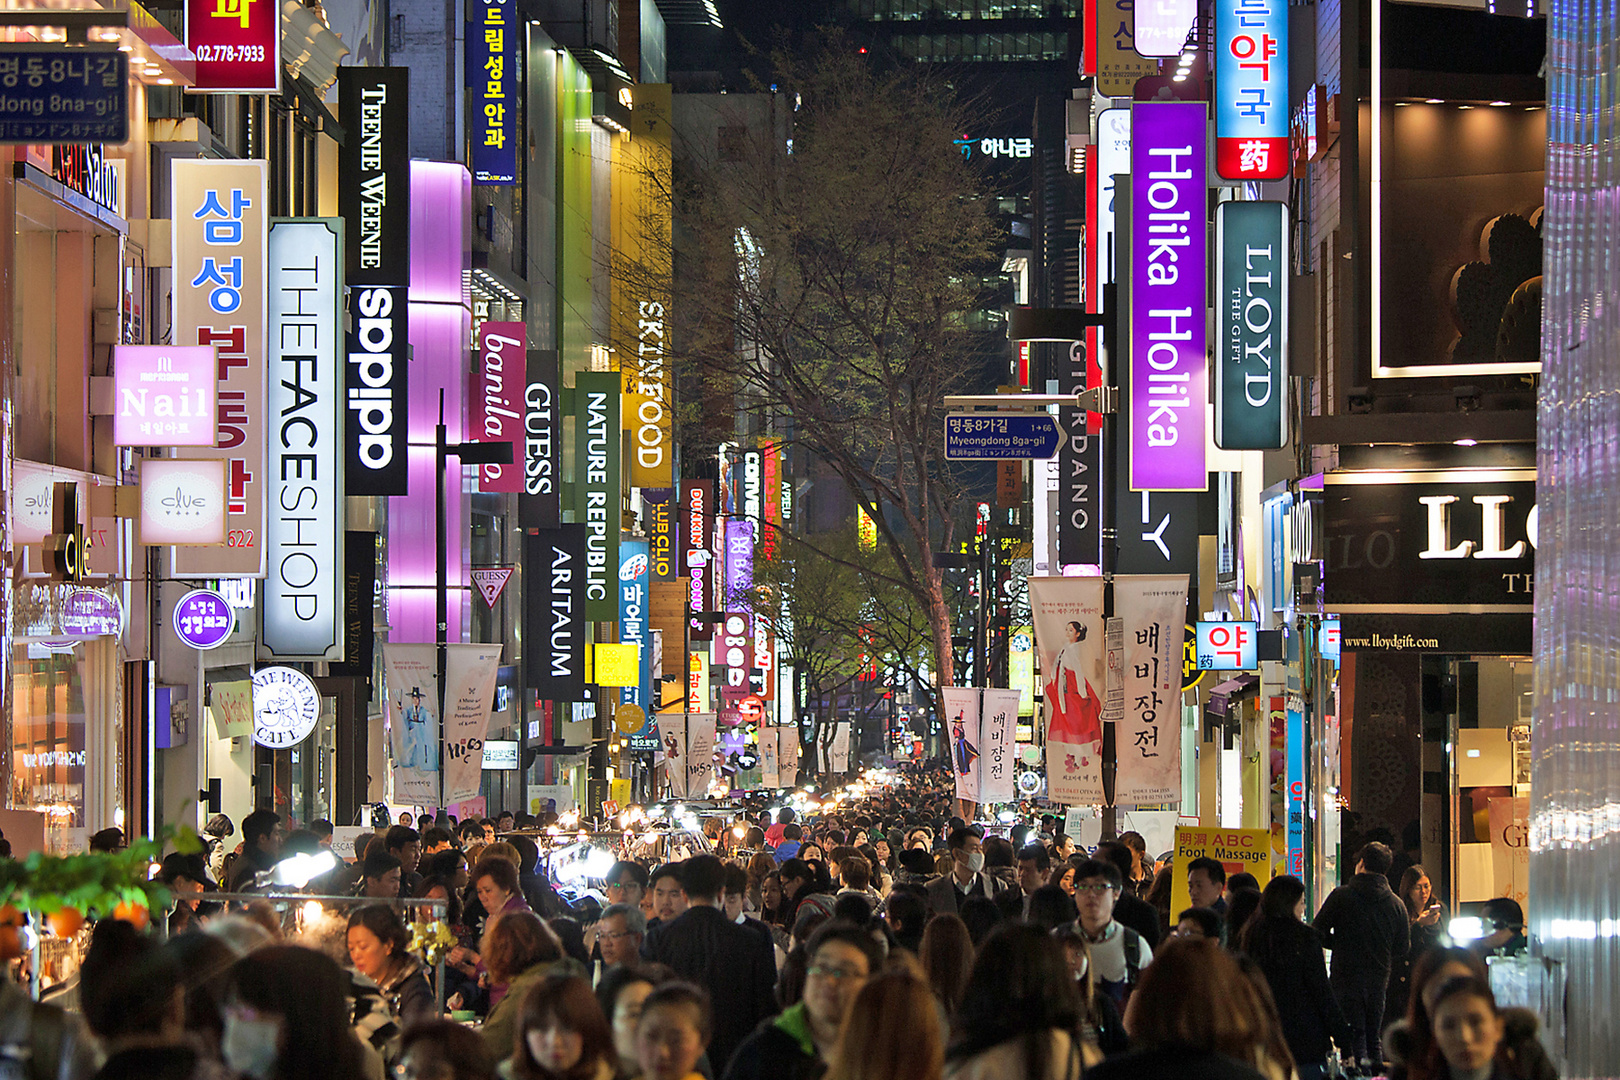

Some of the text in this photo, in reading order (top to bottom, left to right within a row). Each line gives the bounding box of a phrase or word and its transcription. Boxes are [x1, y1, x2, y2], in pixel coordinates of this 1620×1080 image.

[196, 46, 265, 63] 02.778-7933
[50, 95, 119, 116] 8na-gil
[980, 138, 1034, 159] 하나금
[1239, 140, 1270, 172] 药
[361, 84, 386, 269] TEENIE WEENIE
[1147, 145, 1192, 447] Holika Holika
[1231, 287, 1242, 364] THE GIFT
[1245, 244, 1273, 408] LLOYD
[349, 288, 393, 470] adidas
[484, 333, 521, 437] banila
[637, 301, 665, 468] SKINFOOD
[121, 386, 208, 417] Nail
[524, 382, 553, 495] GUESS
[949, 418, 1008, 433] 명동8가길
[949, 436, 1046, 447] Myeongdong 8ga-gil
[587, 392, 607, 600] NATURE REPUBLIC
[474, 572, 507, 580] GUESS
[550, 546, 573, 677] ARITAUM
[1208, 626, 1248, 667] 약
[1344, 634, 1439, 650] www.lloydgift.com
[1134, 622, 1163, 758] 배비장전
[257, 728, 299, 743] CAFE
[1178, 846, 1267, 864] Foot Massage
[1179, 833, 1254, 848] 明洞 ABC
